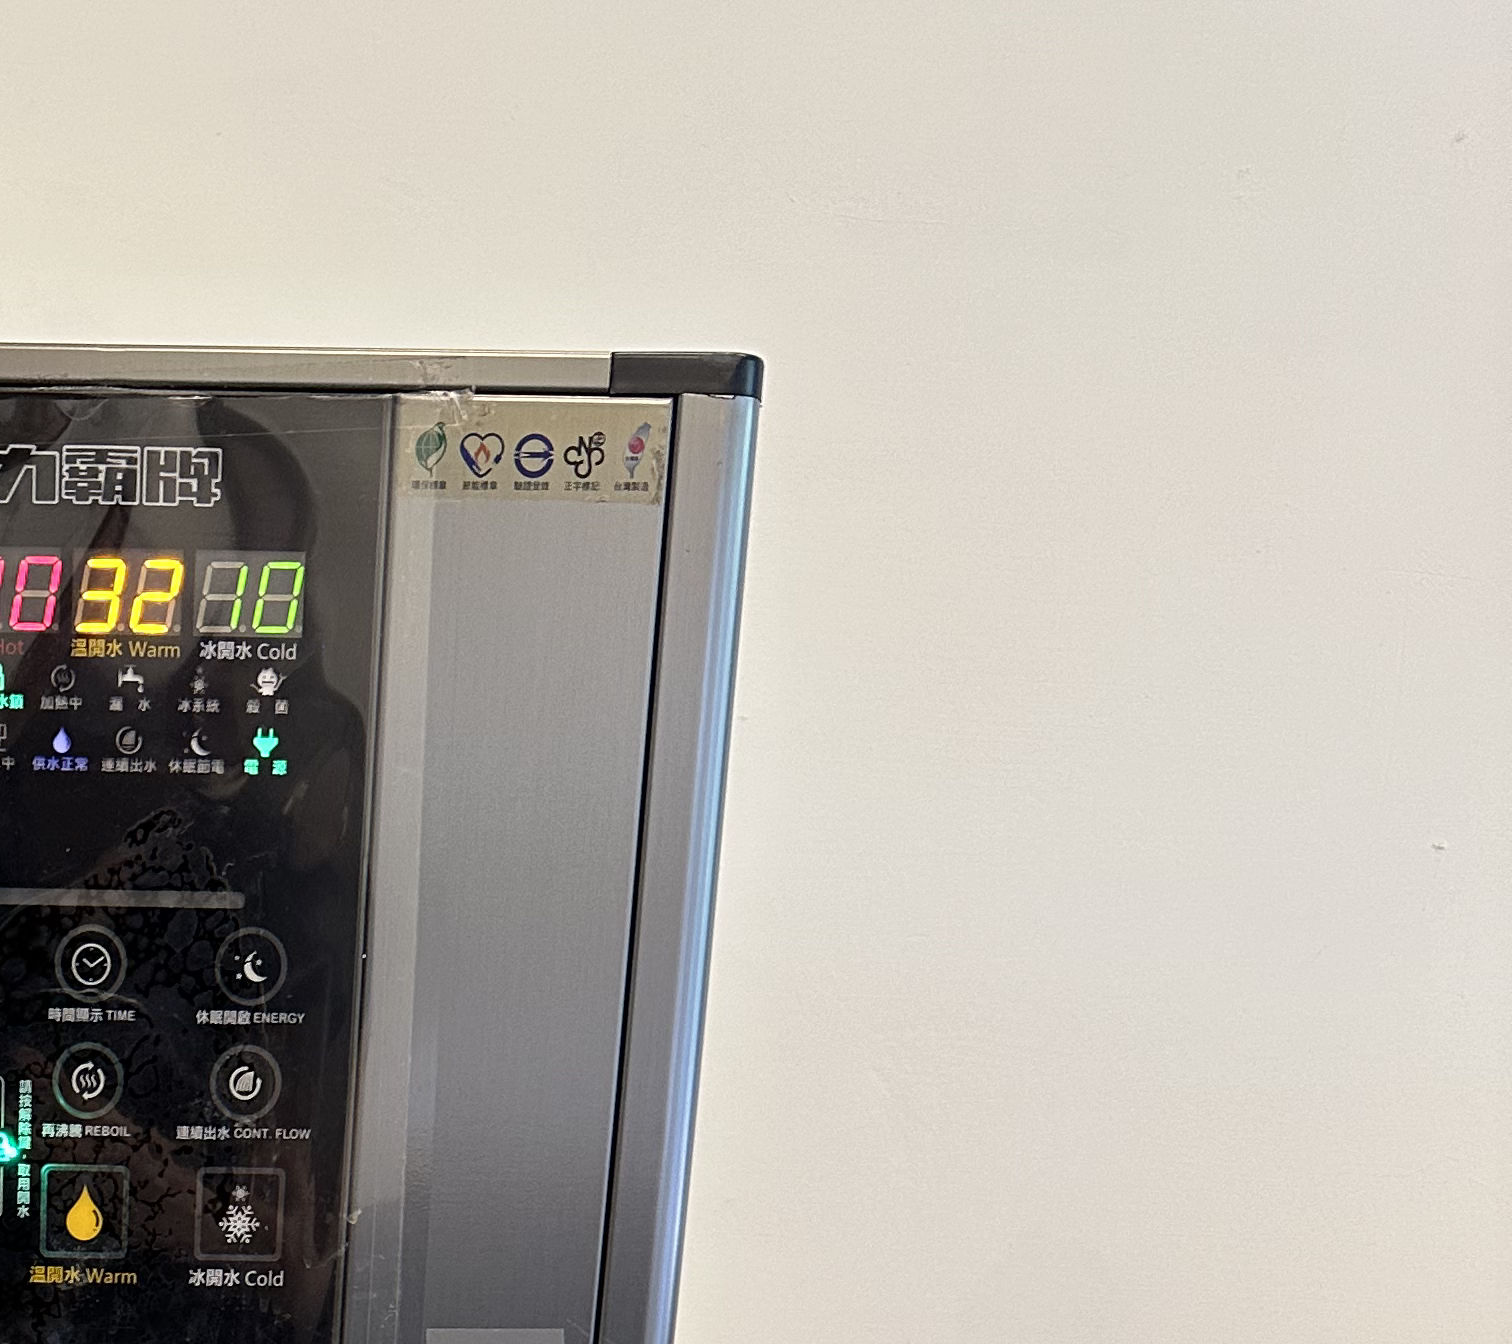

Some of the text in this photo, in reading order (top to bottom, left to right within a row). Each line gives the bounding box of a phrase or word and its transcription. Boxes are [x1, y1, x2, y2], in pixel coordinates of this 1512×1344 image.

[74, 556, 185, 635] 32
[229, 561, 305, 633] 10
[129, 640, 181, 658] Warm
[199, 640, 297, 661] 冰開水 Cold
[105, 1010, 136, 1022] TIME
[253, 1012, 305, 1024] ENERGY
[85, 1125, 131, 1137] REBOIL
[275, 1128, 312, 1140] FLOW
[85, 1267, 138, 1285] Warm
[188, 1268, 284, 1288] 冰開水 Cold
